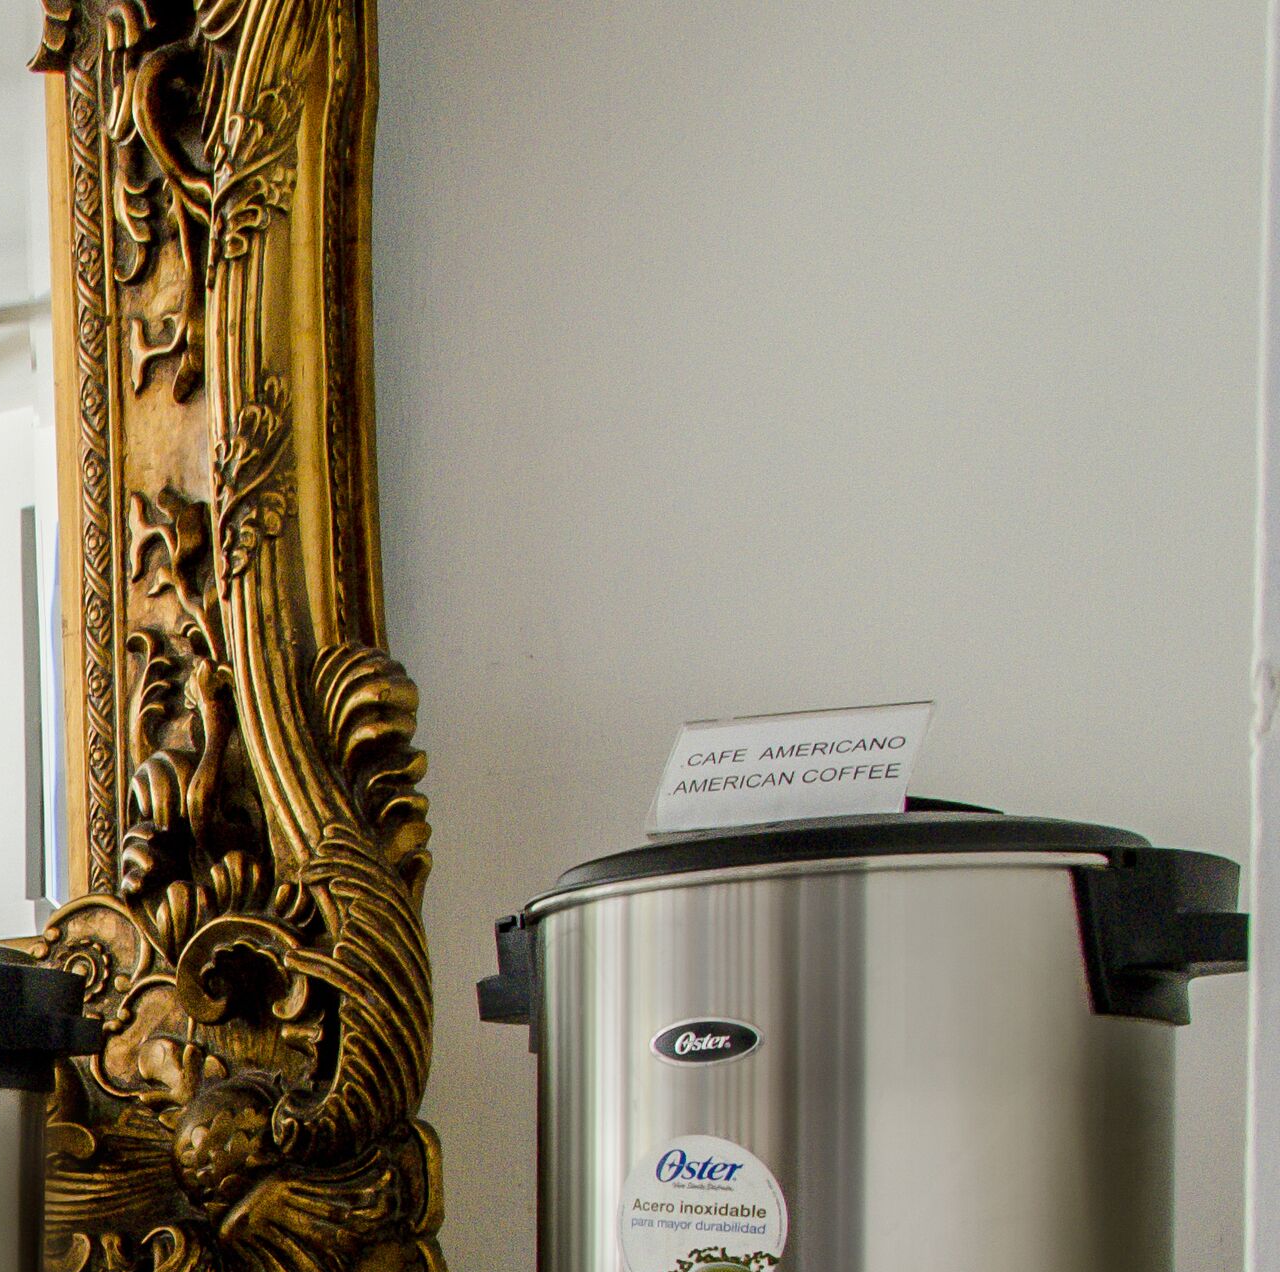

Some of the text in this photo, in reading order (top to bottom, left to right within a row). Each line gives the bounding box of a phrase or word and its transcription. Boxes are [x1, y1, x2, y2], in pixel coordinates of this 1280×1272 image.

[687, 735, 907, 767] CAFE AMERICANO
[673, 763, 902, 796] AMERICAN COFFEE
[674, 1031, 731, 1056] Oster
[655, 1149, 744, 1183] Oster
[632, 1198, 767, 1220] Acero inoxidable
[631, 1217, 767, 1236] para mayor durabilidad
